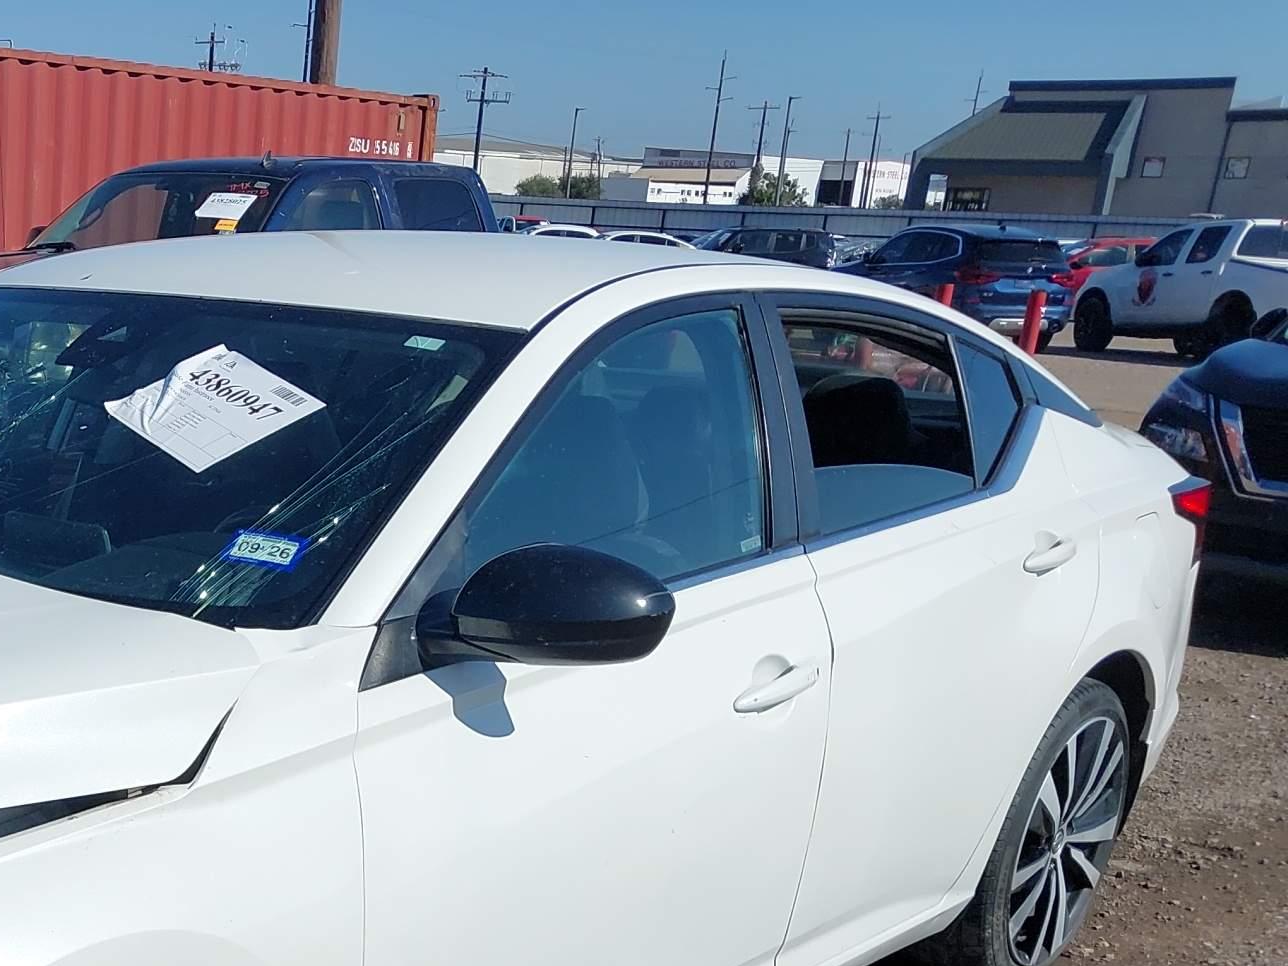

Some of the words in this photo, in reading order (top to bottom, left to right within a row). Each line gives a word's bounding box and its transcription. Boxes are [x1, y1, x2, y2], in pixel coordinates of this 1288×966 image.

[189, 369, 284, 421] 43860947
[238, 540, 261, 554] 09
[267, 544, 292, 559] 26
